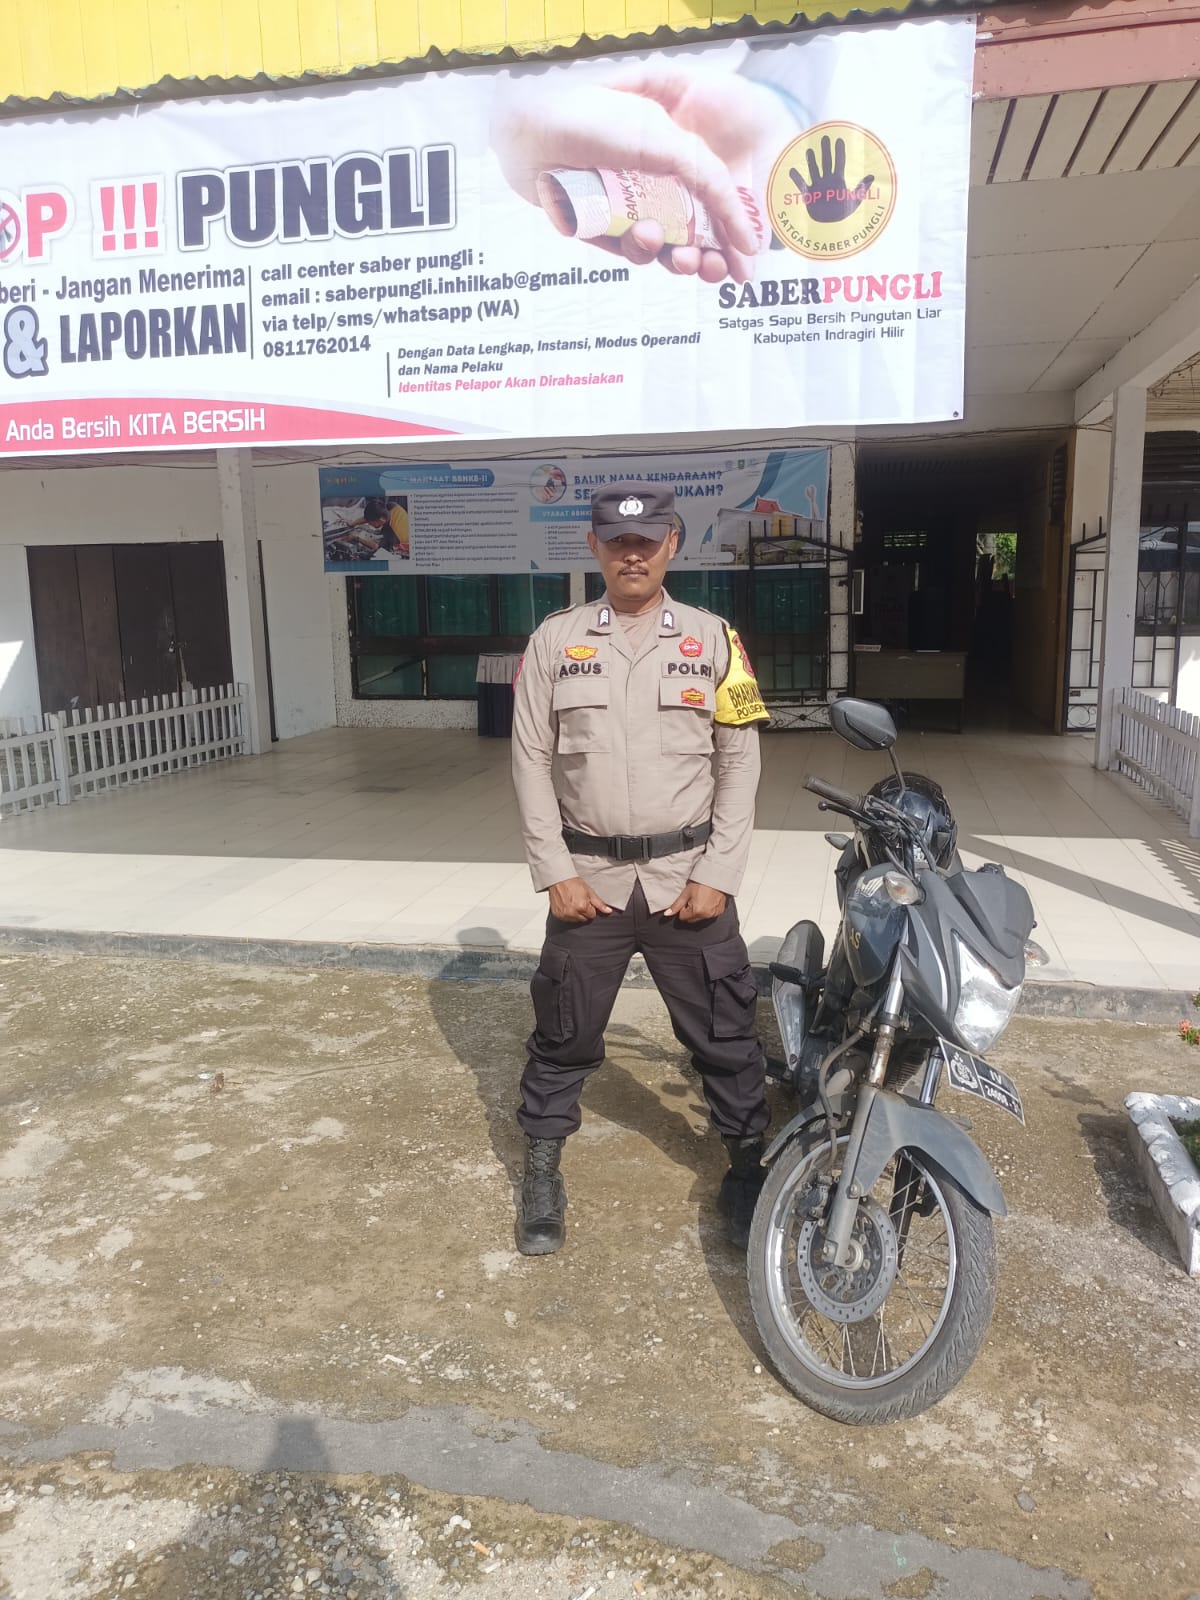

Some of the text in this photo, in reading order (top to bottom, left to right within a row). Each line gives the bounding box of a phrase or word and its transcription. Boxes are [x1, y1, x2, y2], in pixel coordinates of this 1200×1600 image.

[179, 146, 454, 250] PUNGLI
[784, 187, 880, 206] STOP PUNGLI
[778, 210, 812, 249] SATGAS
[813, 239, 851, 252] SABER
[852, 204, 885, 245] PUNGLI
[261, 264, 292, 282] call
[297, 260, 355, 279] center
[359, 256, 411, 274] saber
[416, 249, 473, 273] pungli
[56, 275, 131, 303] Jangan
[139, 264, 245, 293] Menerima
[261, 288, 310, 307] email
[325, 267, 630, 302] saberpungli.inhilkab@gmail.com
[262, 299, 520, 332] via telp/sms/whatsapp (WA)
[719, 306, 942, 330] Satgas Sapu Bersih Pungutan Liar
[4, 302, 247, 379] & LAPORKAN
[263, 335, 371, 357] 0811762014
[397, 331, 701, 360] Dengan Data Lengkap, Instansi, Modus Operandi
[753, 326, 905, 345] Kabupaten Indragiri Hilir
[398, 360, 504, 376] dan Nama Pelaku
[398, 372, 624, 393] Identitas Pelapor Akan Dirahasiakan
[5, 408, 265, 441] Anda Bersih KITA BERSIH
[573, 474, 606, 485] BALIK
[646, 470, 723, 482] KENDARAAN?
[558, 662, 602, 678] AGUS
[667, 662, 712, 678] POLRI
